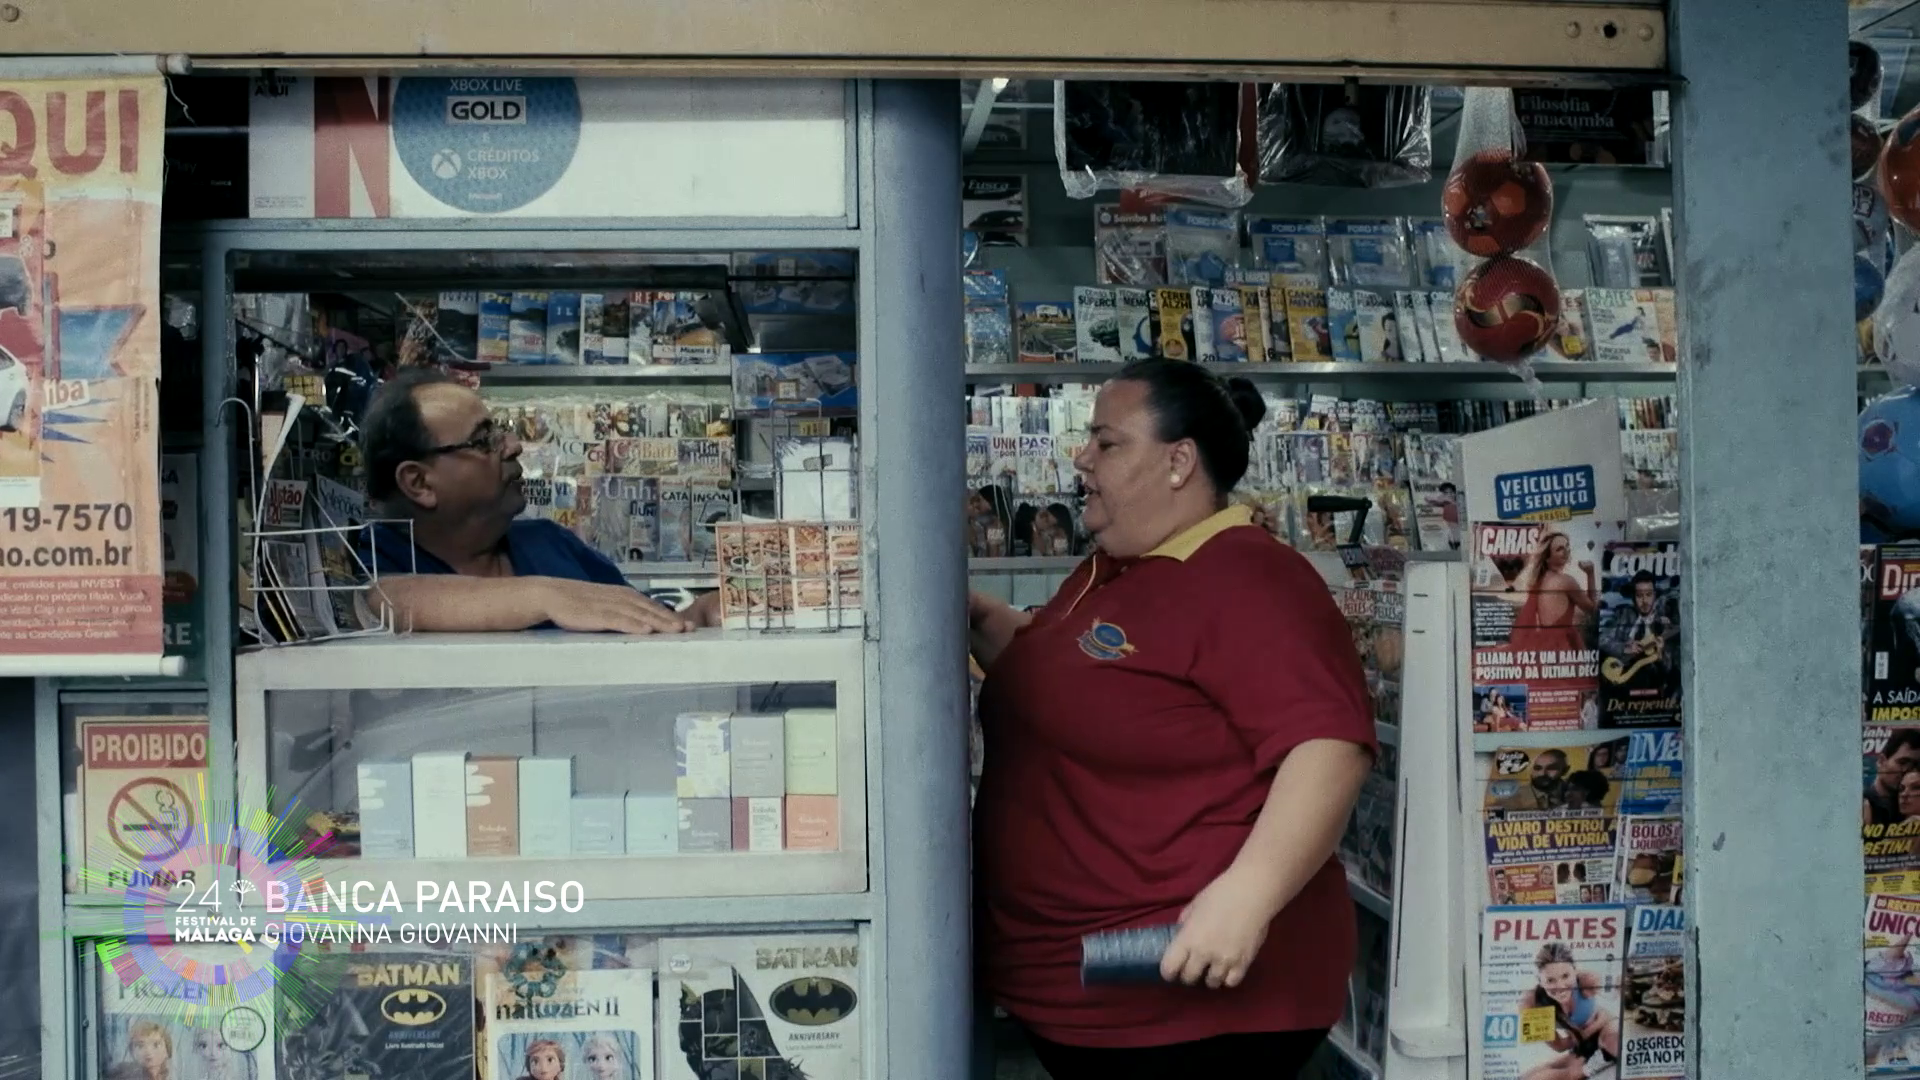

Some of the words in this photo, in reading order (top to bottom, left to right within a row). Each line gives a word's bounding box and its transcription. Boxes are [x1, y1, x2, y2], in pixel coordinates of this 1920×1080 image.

[255, 85, 289, 97] AUI
[450, 79, 489, 91] XBOX
[493, 79, 522, 91] LIVE
[451, 101, 521, 120] GOLD
[1520, 95, 1590, 113] Filosofia
[1534, 112, 1615, 128] macumba
[467, 146, 539, 163] CRÉDITOS
[467, 166, 508, 180] XBOX
[1500, 471, 1586, 497] VEÍCULOS
[1503, 497, 1521, 512] DE
[1525, 489, 1589, 509] SERVIÇO
[1481, 528, 1539, 555] CARAS
[81, 578, 121, 589] INVEST
[1476, 651, 1513, 665] ELIANA
[1517, 651, 1537, 664] FAZ
[1540, 650, 1556, 664] UM
[1476, 665, 1522, 679] POSITIVO
[1525, 666, 1539, 679] DA
[1606, 698, 1625, 712] De
[1872, 690, 1884, 705] A
[91, 734, 206, 763] PROIBIDO
[1632, 824, 1672, 838] BOLOS
[1497, 836, 1528, 850] VIDA
[1533, 834, 1551, 849] DE
[108, 870, 196, 887] FUMAR
[1494, 916, 1617, 941] PILATES
[1570, 942, 1585, 950] EM
[1588, 941, 1615, 949] CASA
[1636, 942, 1648, 954] 13
[756, 947, 858, 970] BATMAN
[357, 963, 460, 986] BATMAN
[1487, 1016, 1515, 1039] 40
[789, 1032, 839, 1041] ANNIVERSARY
[1627, 1040, 1635, 1052] O
[1654, 1051, 1671, 1063] NO
